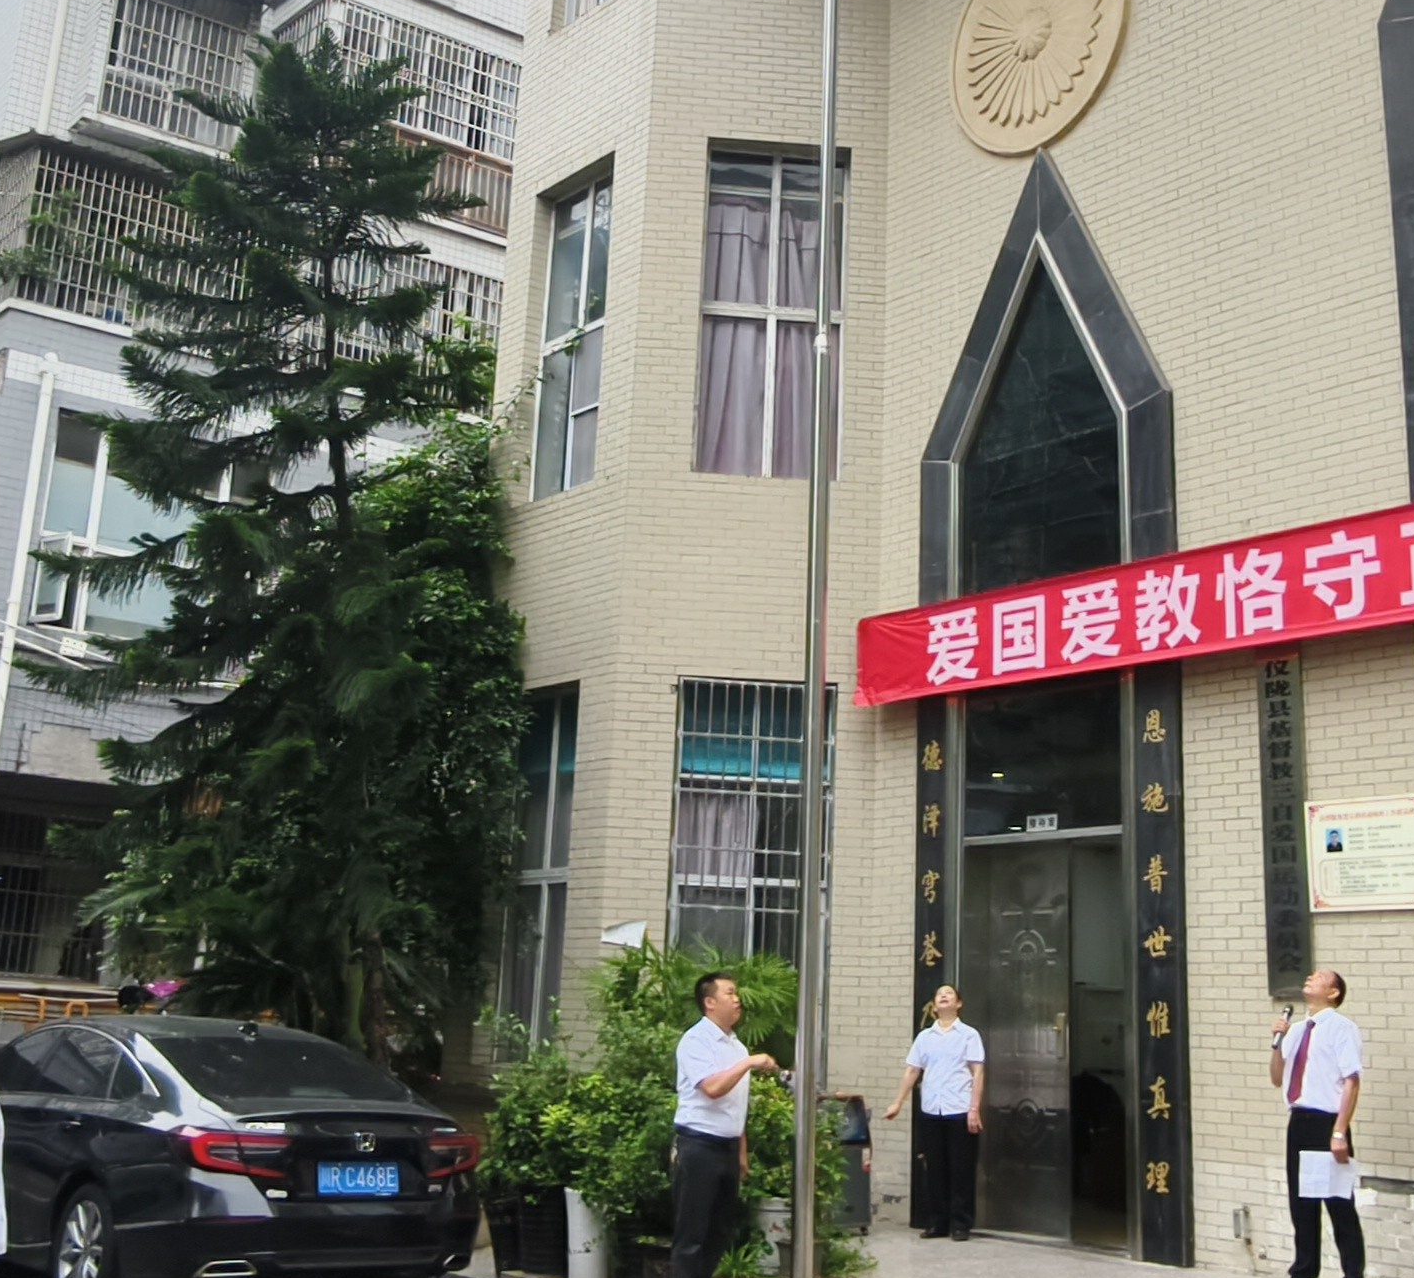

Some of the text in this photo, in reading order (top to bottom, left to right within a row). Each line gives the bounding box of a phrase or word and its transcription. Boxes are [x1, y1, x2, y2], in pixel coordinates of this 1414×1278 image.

[1141, 709, 1173, 1195] 恩施普世惟真理
